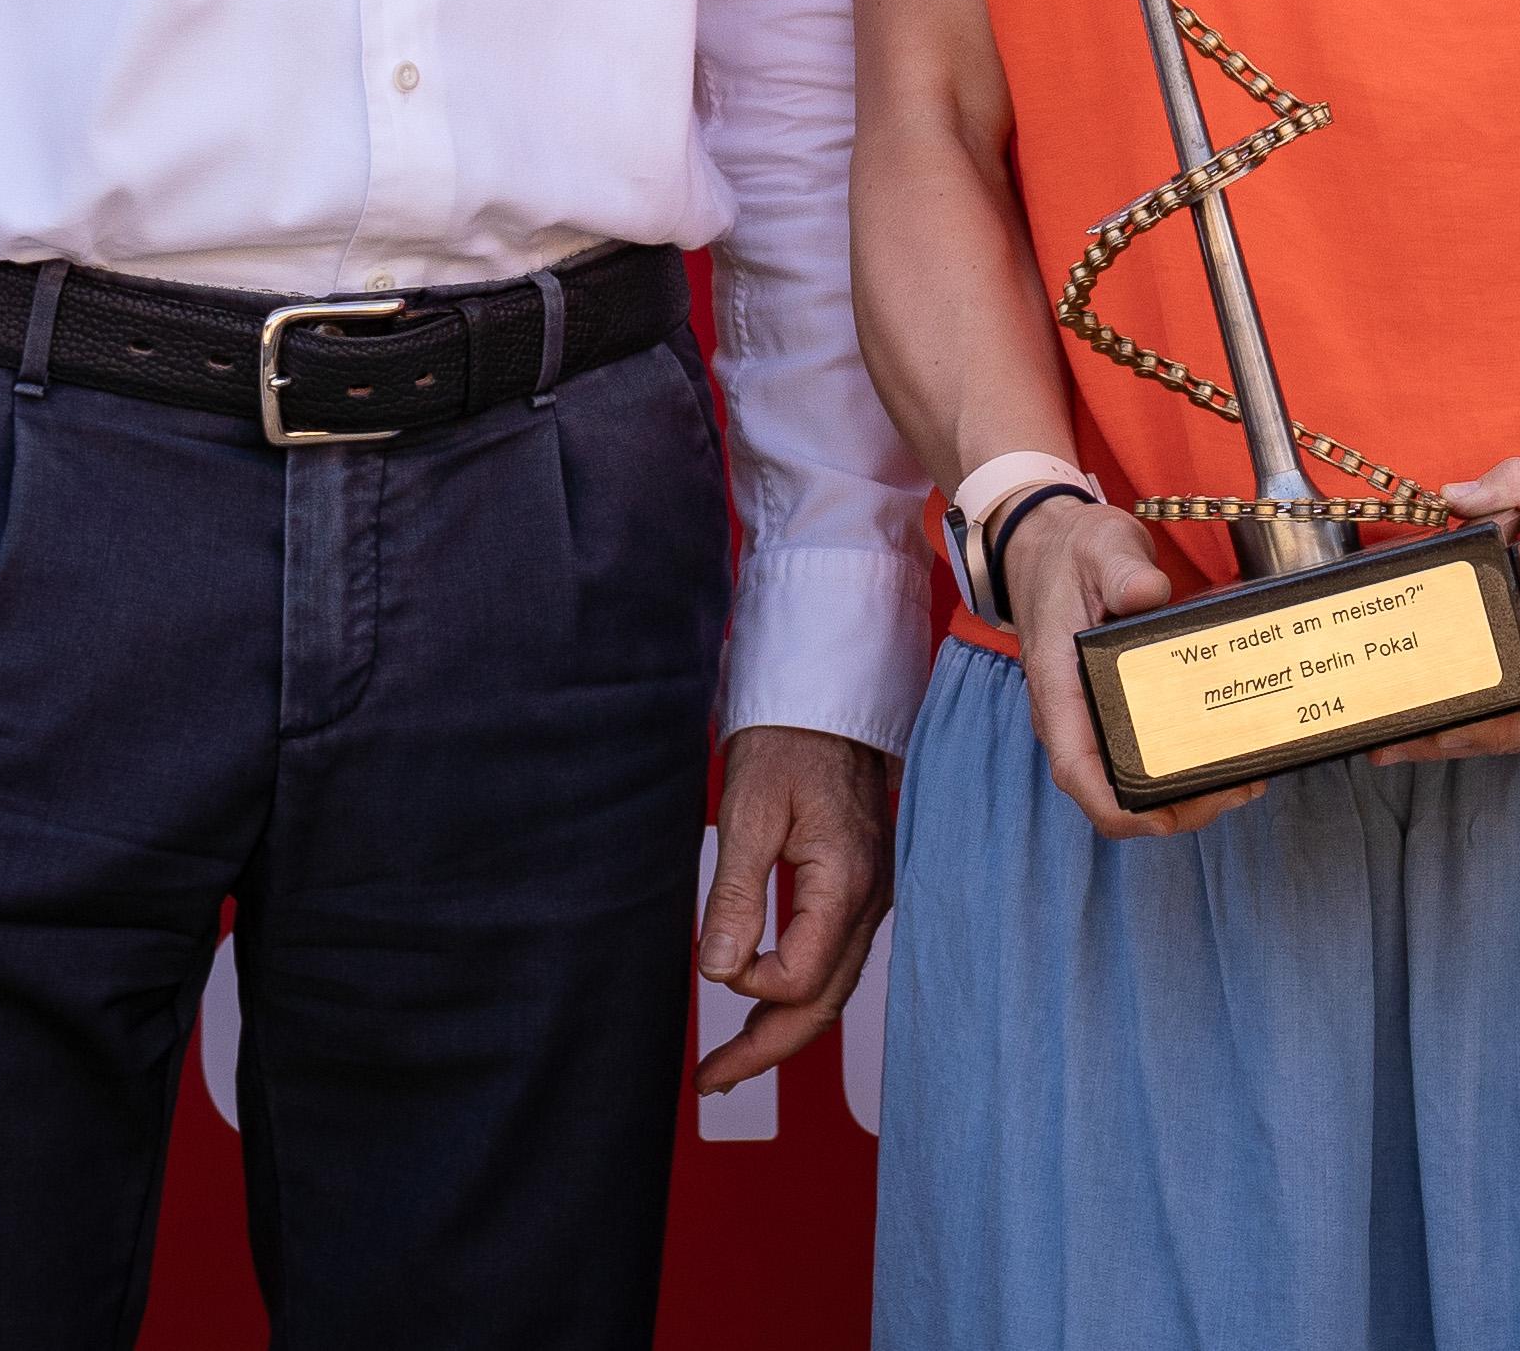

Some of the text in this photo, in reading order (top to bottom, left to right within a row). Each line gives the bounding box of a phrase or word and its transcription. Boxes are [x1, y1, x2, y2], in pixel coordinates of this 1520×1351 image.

[1171, 584, 1424, 665] "Wer radelt am meisten?"
[1203, 632, 1418, 706] mehrwert Berlin Pokal
[1296, 697, 1345, 724] 2014
